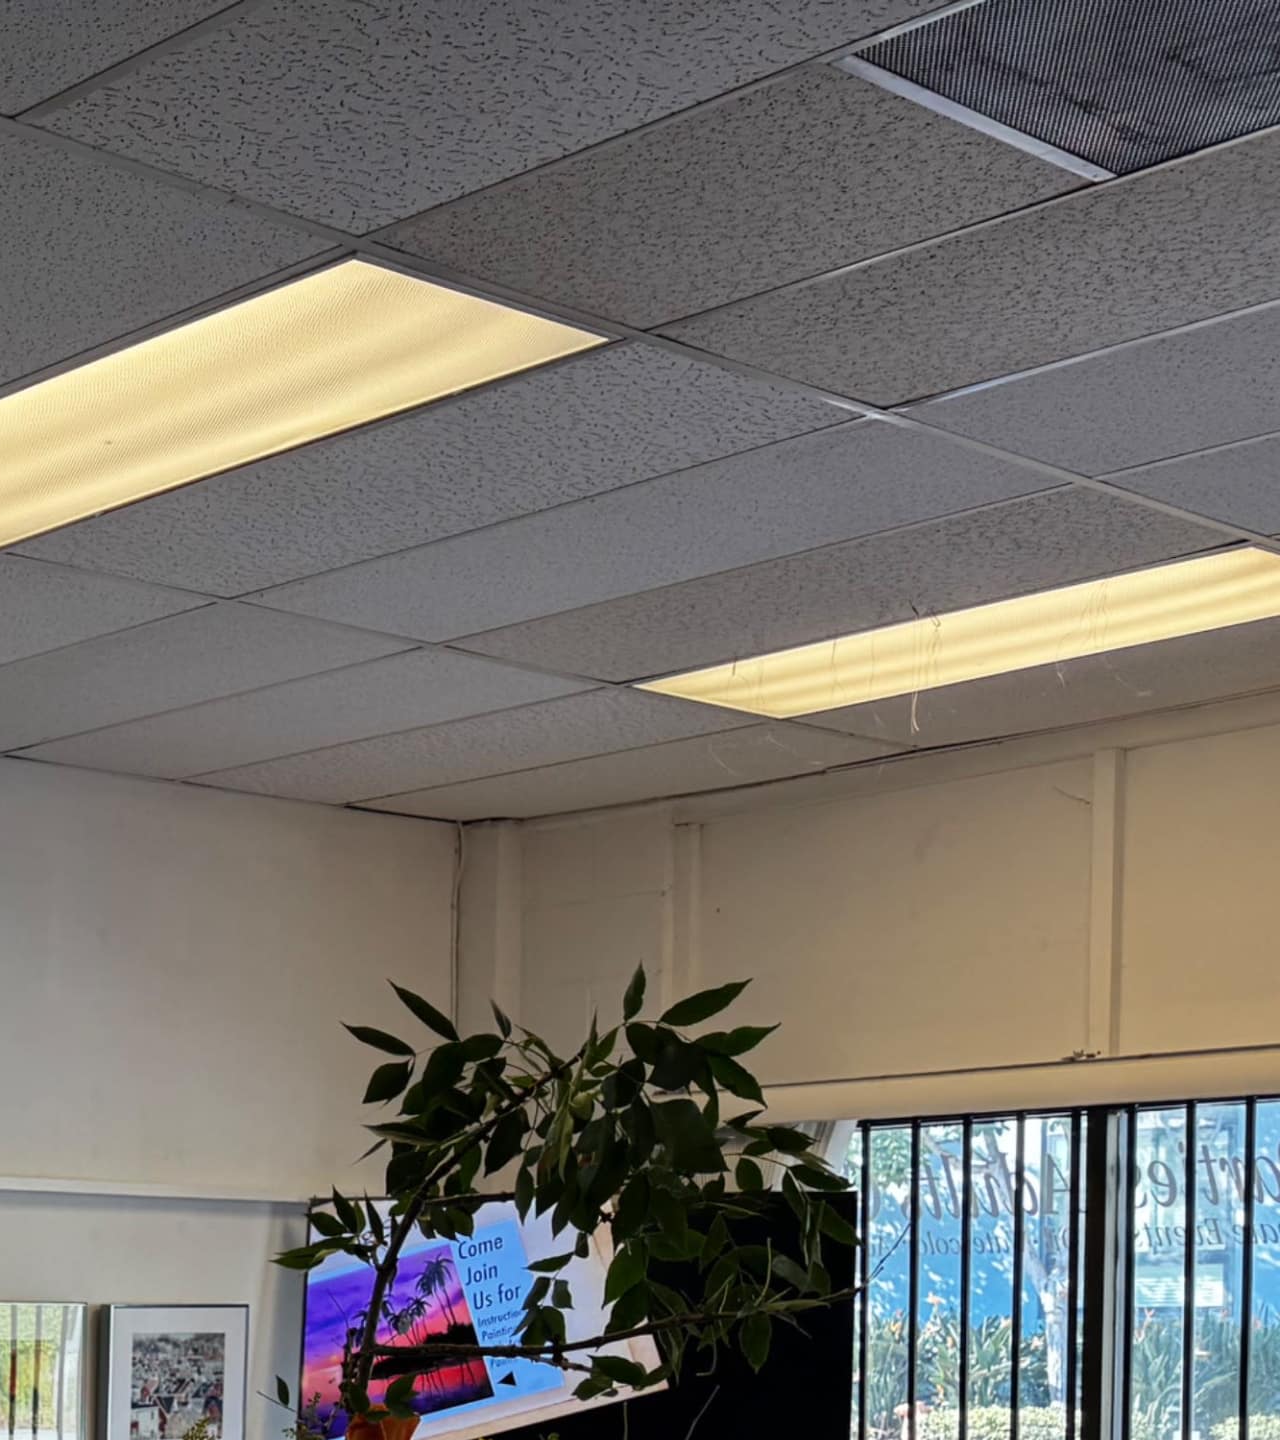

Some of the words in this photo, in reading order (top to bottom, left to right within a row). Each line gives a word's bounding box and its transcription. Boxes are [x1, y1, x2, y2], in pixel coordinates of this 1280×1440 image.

[458, 1236, 503, 1259] Come
[465, 1263, 498, 1286] Join
[472, 1290, 493, 1310] Us
[498, 1282, 522, 1304] for
